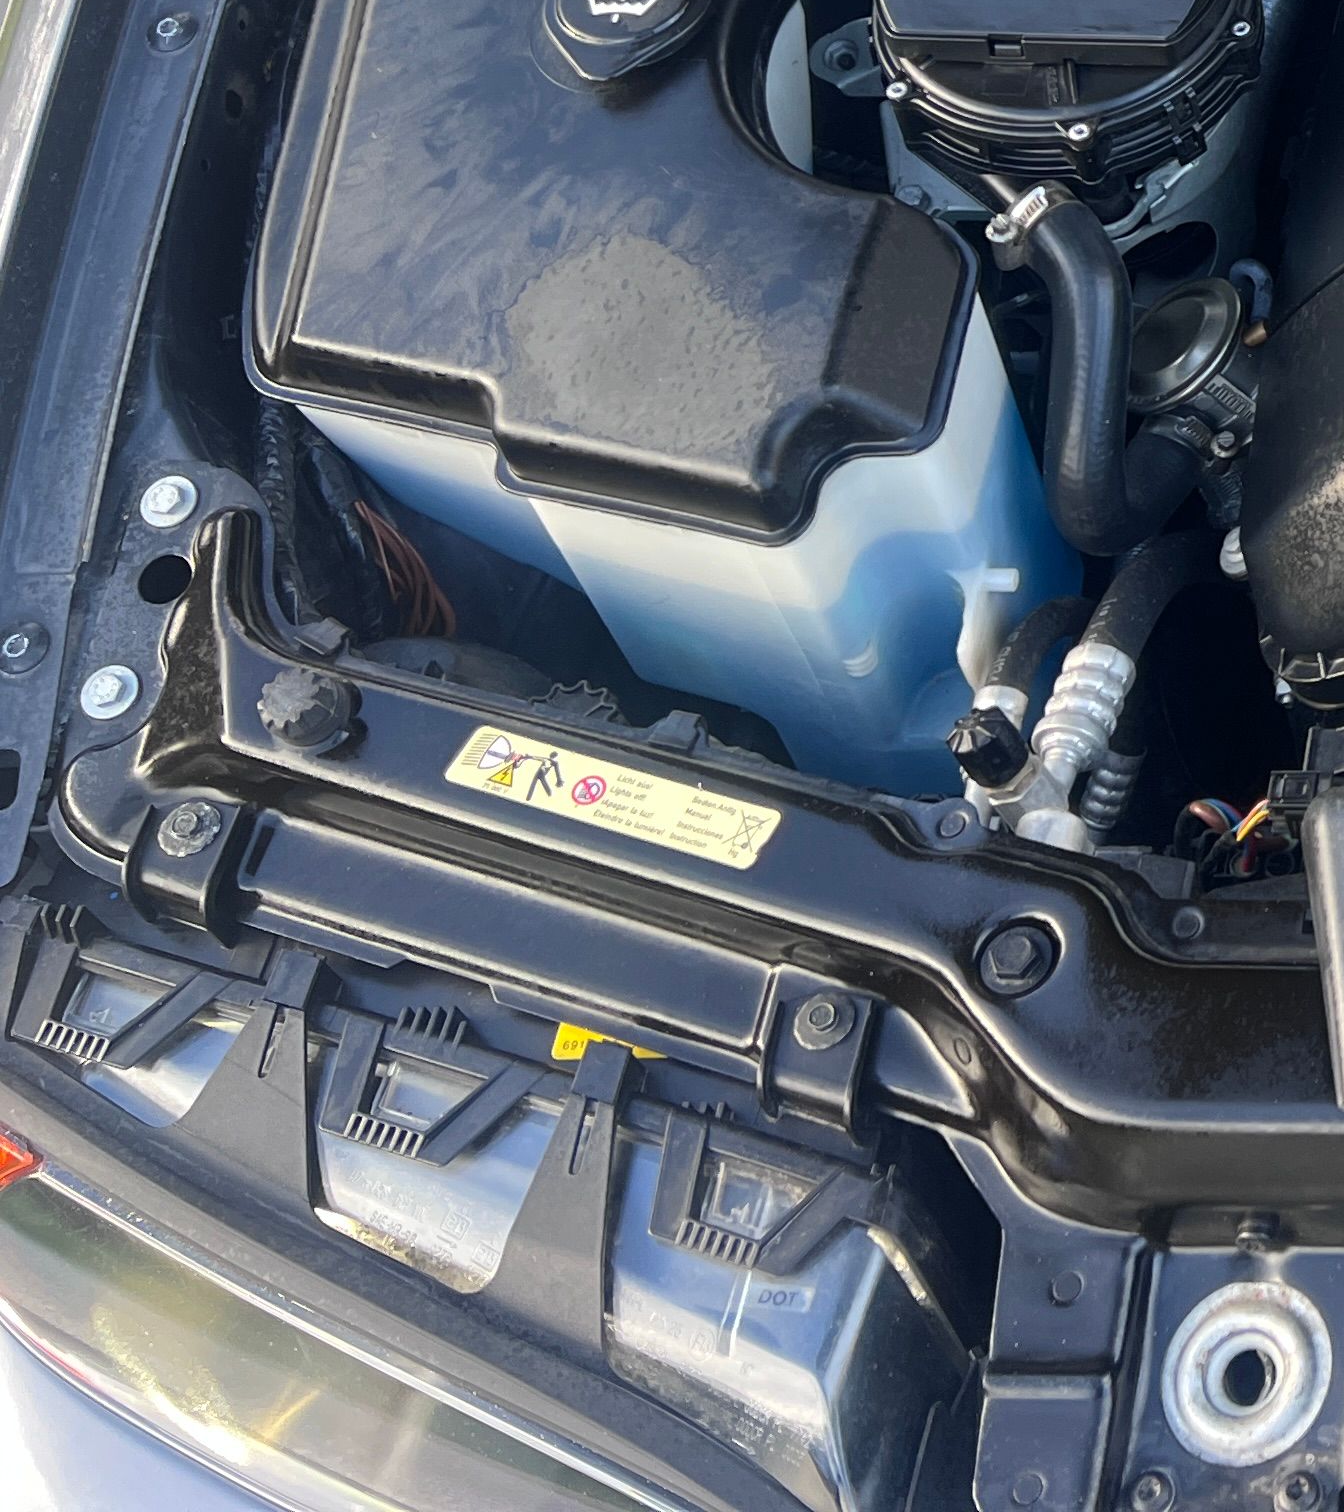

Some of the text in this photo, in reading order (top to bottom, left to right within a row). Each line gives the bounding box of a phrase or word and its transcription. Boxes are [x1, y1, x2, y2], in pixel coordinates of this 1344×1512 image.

[617, 774, 635, 785] Licht
[610, 786, 632, 797] Lights
[686, 807, 713, 821] Manual
[676, 820, 724, 840] Instrucciones
[669, 832, 708, 849] Instruction
[757, 1289, 800, 1307] DOT
